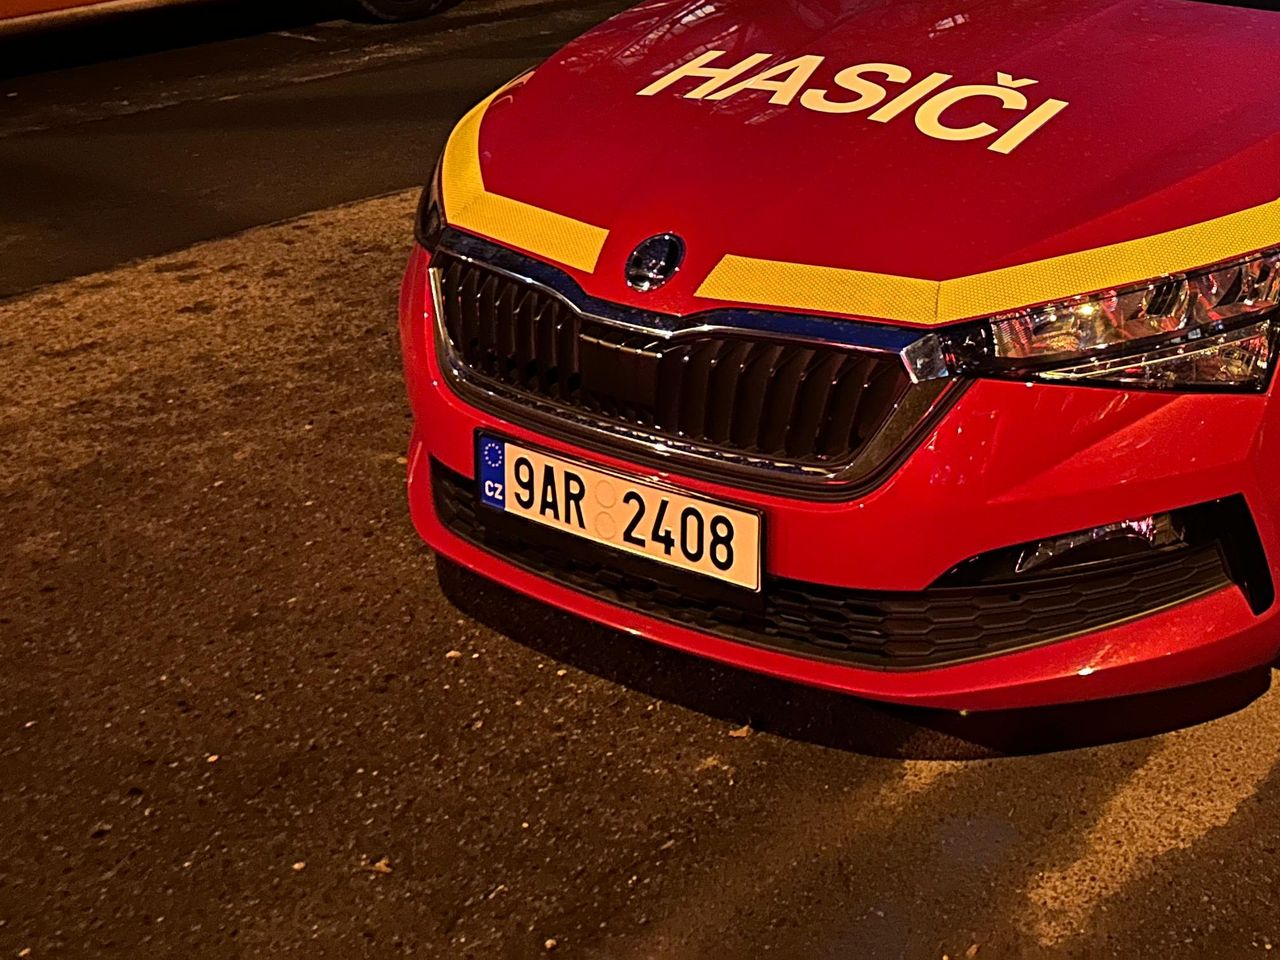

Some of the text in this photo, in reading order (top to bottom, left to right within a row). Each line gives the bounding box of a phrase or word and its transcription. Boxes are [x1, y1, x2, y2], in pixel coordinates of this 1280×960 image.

[636, 50, 1069, 154] HASIČI
[484, 480, 503, 500] CZ
[514, 457, 734, 571] 9AR 2408
